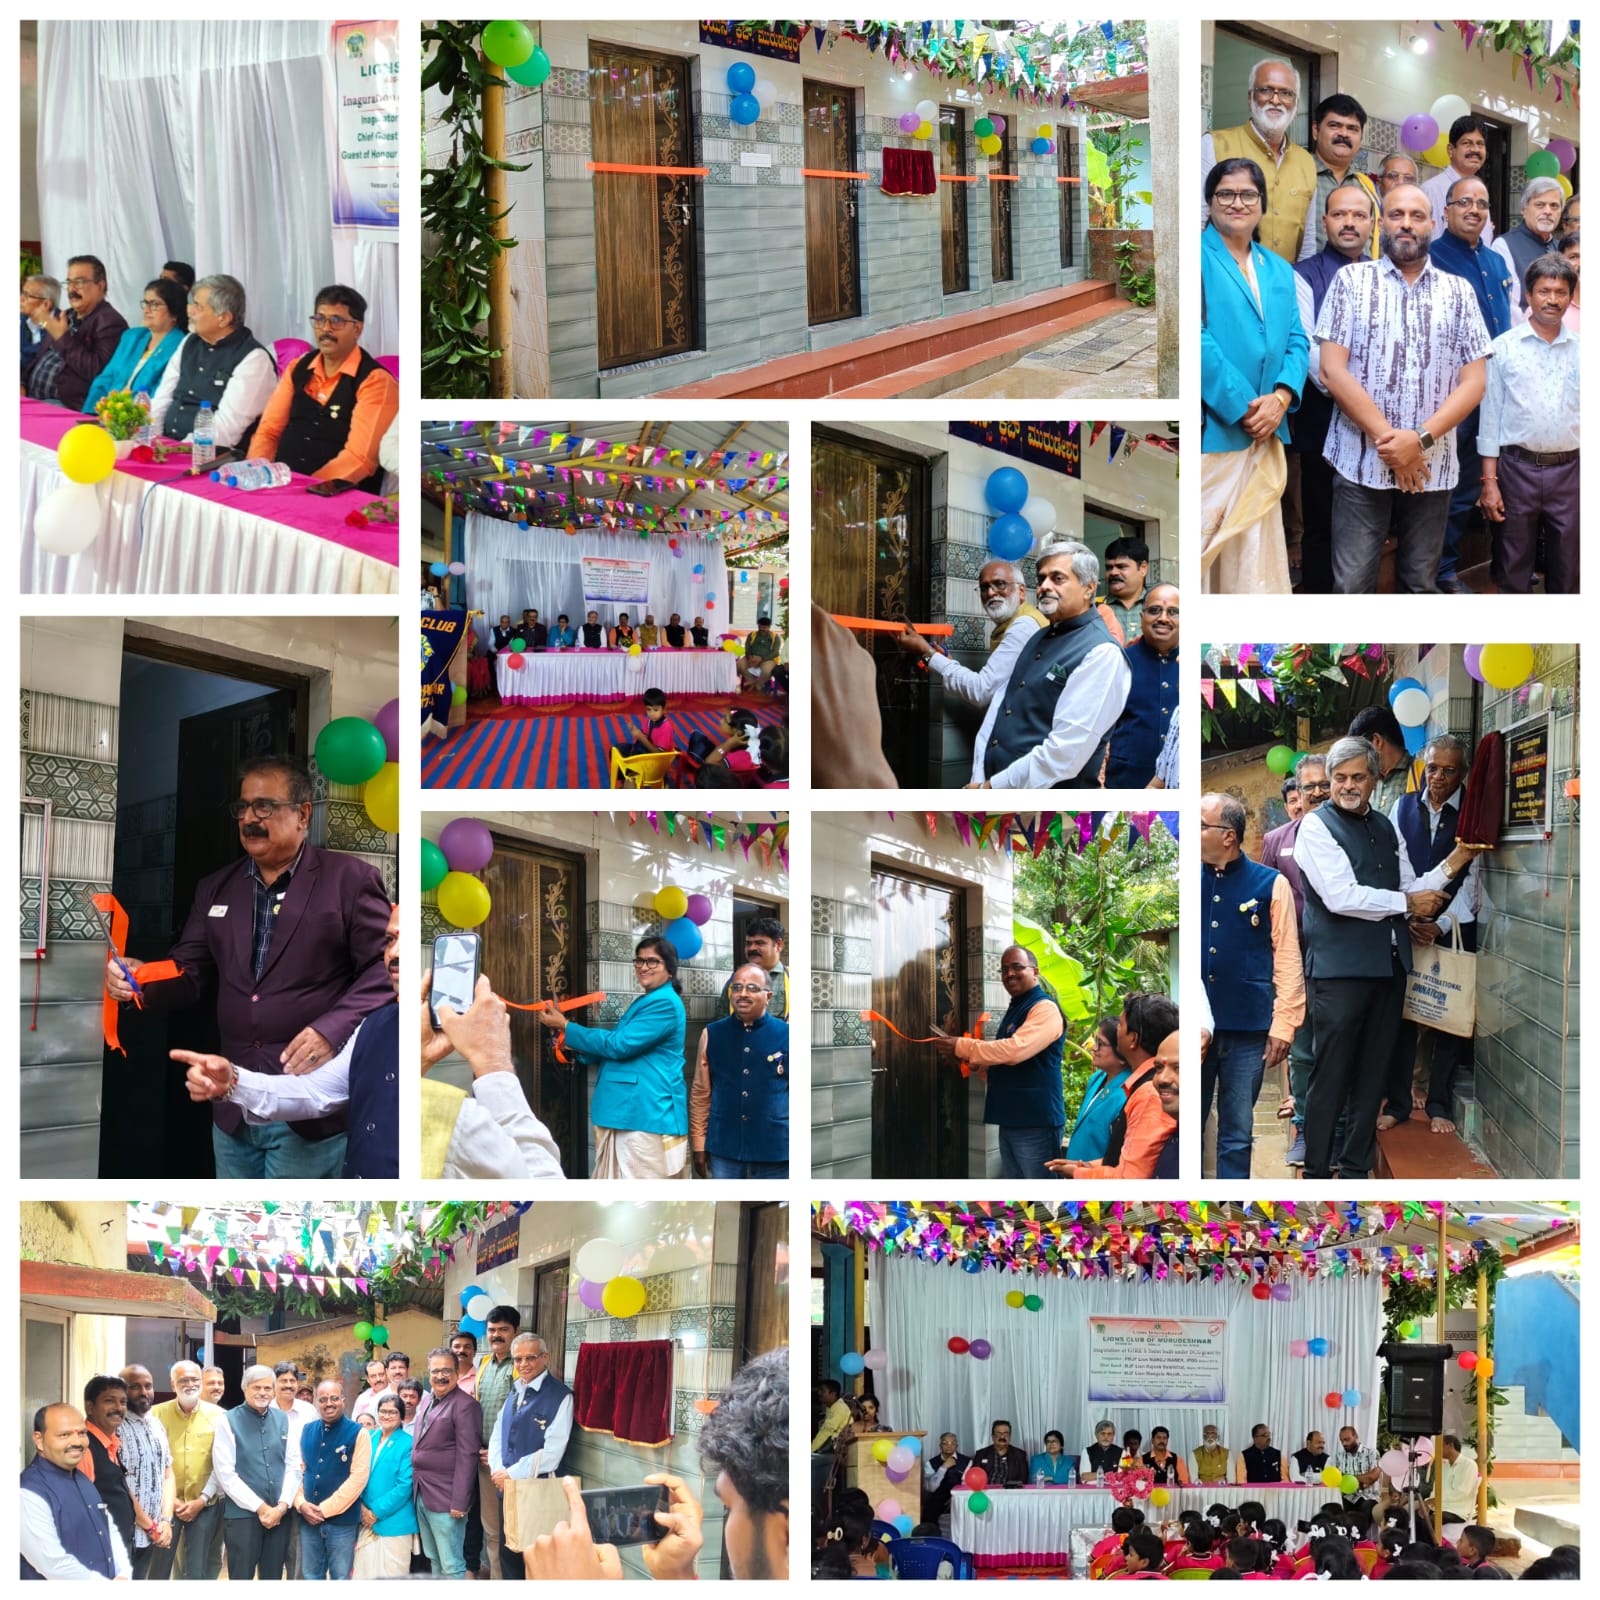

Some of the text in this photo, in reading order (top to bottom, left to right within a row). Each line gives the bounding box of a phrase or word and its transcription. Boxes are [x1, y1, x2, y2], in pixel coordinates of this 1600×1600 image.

[341, 150, 362, 160] Guest
[363, 149, 371, 159] of
[420, 616, 457, 633] CLUB
